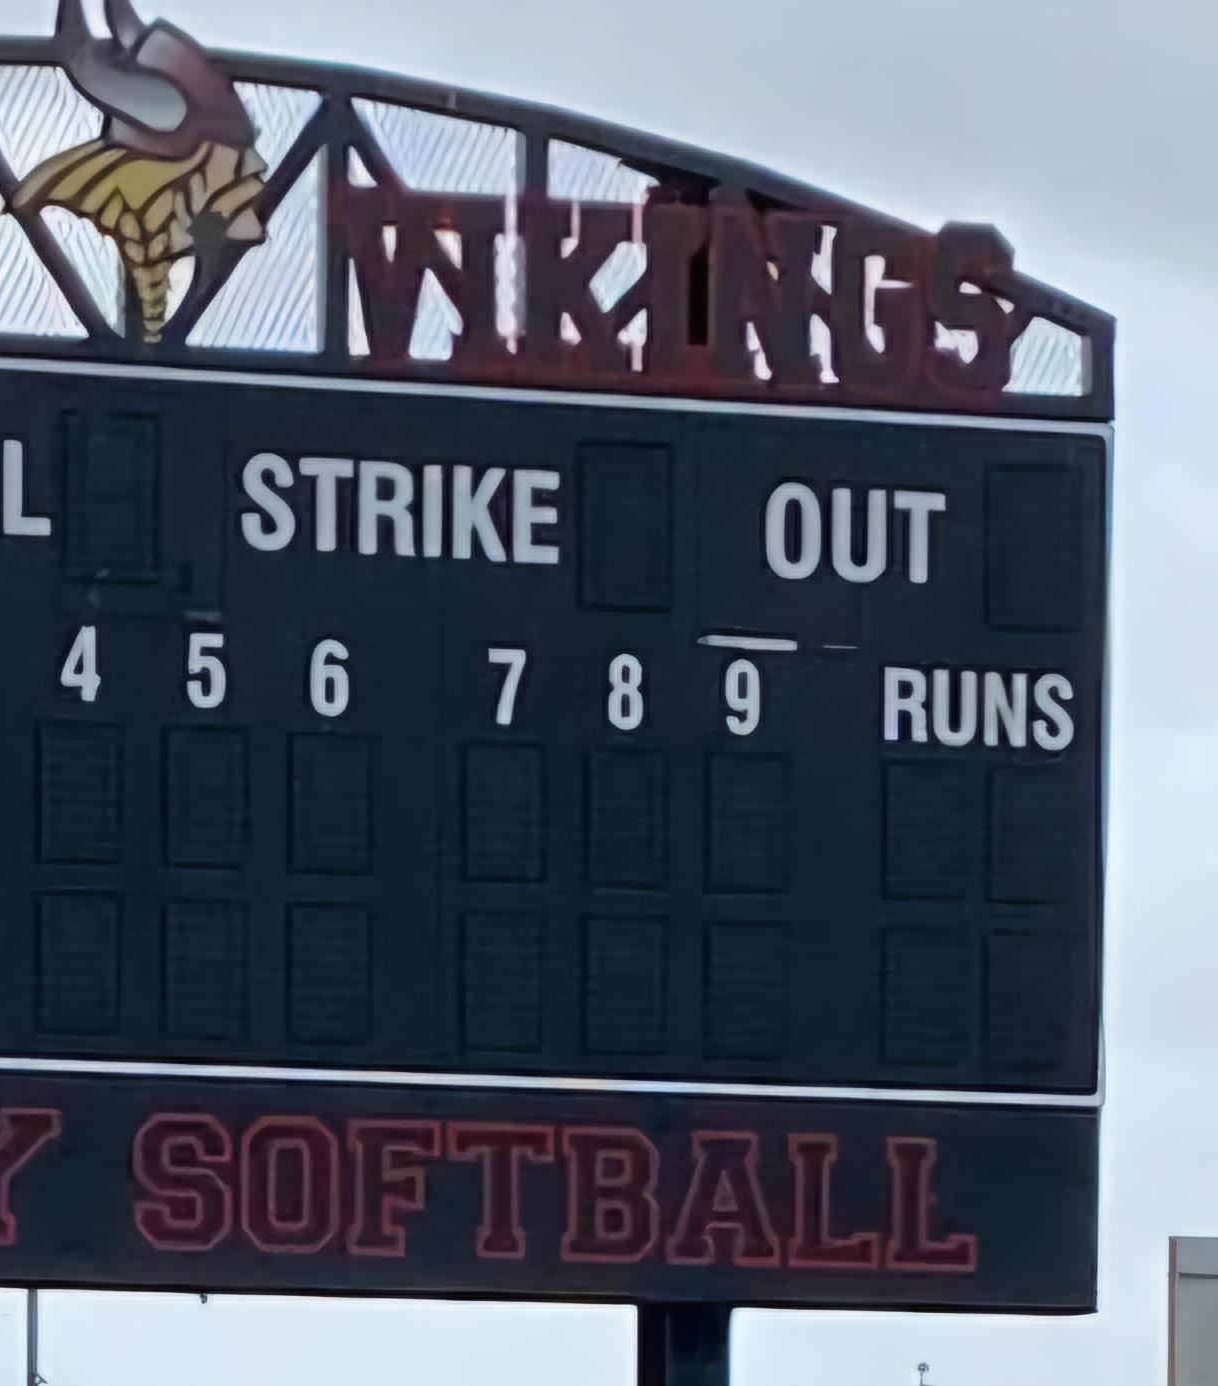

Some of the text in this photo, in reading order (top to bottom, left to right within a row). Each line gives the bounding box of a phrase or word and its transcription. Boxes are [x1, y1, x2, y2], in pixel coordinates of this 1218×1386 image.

[342, 188, 1016, 394] VIKINGS
[240, 451, 561, 566] STRIKE
[764, 481, 947, 585] OUT
[59, 624, 102, 703] 4
[186, 631, 227, 710] 5
[309, 638, 350, 718] 6
[487, 647, 528, 726] 7
[607, 652, 645, 732] 8
[724, 657, 762, 737] 9
[883, 665, 1075, 752] RUNS
[132, 1111, 979, 1274] SOFTBALL
